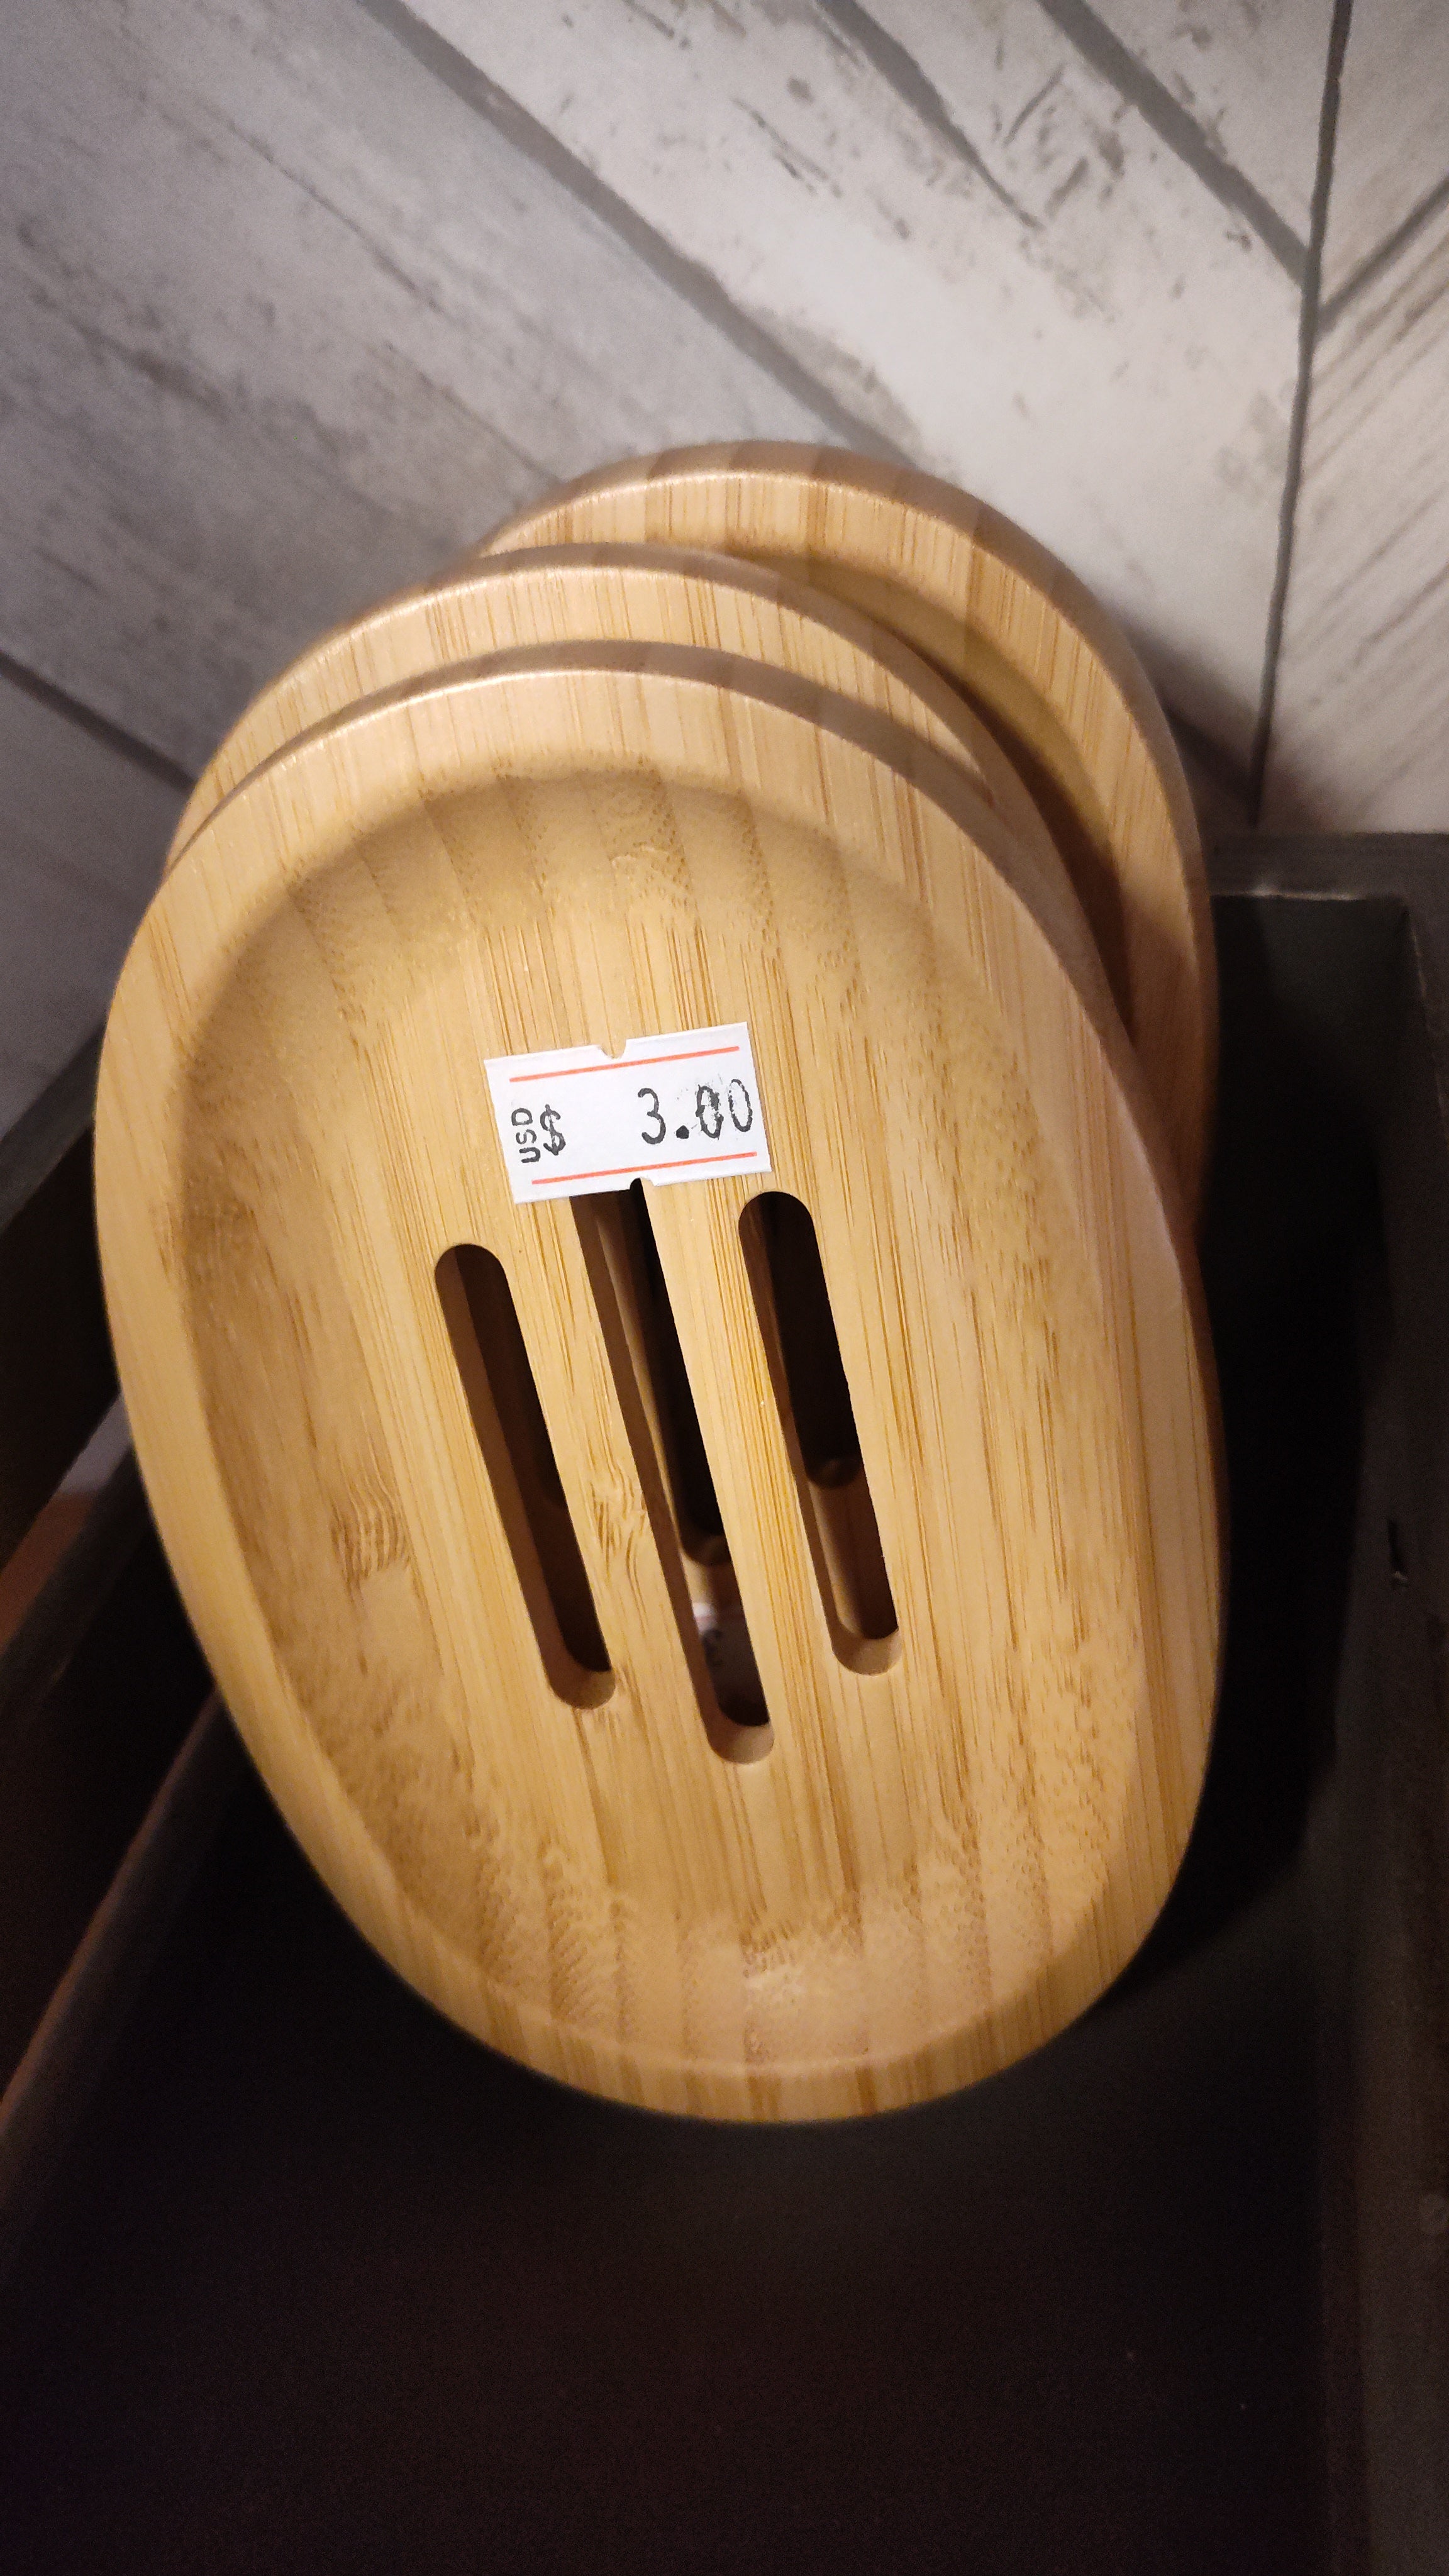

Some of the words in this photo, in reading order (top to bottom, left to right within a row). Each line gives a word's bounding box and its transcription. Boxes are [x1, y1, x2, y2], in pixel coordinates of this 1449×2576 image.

[511, 1108, 541, 1163] USD
[540, 1104, 566, 1156] $
[637, 1079, 753, 1145] 3.00
